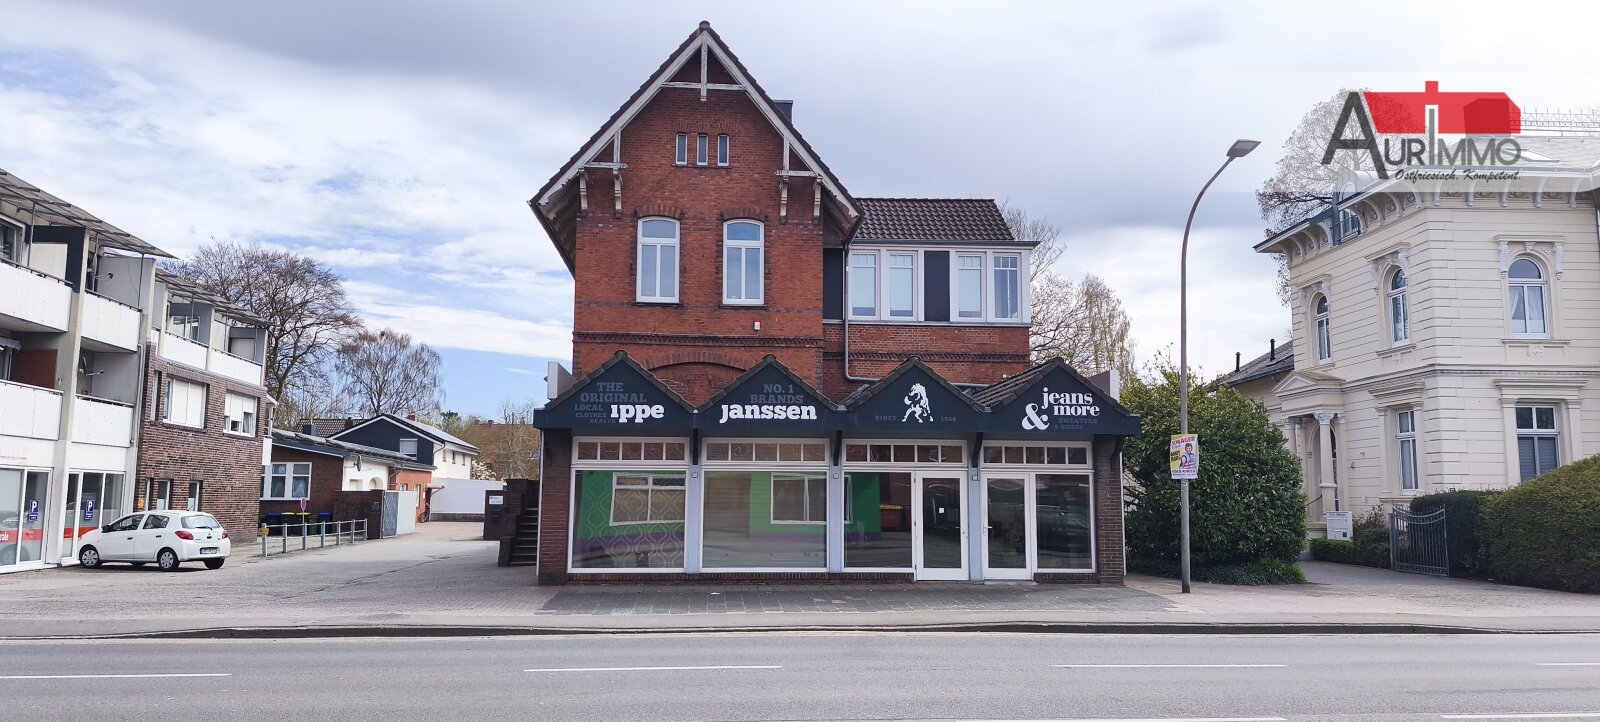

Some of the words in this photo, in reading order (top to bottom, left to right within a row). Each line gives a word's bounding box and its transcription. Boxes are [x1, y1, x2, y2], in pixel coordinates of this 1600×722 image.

[596, 382, 624, 392] THE
[763, 384, 785, 393] NO.
[788, 384, 794, 393] 1
[580, 392, 647, 402] ORIGINAL
[750, 394, 804, 404] BRANDS
[1041, 387, 1093, 409] jeans
[719, 404, 817, 424] janssen
[1021, 403, 1050, 430] &
[1053, 405, 1100, 416] more
[32, 501, 37, 512] P
[88, 501, 92, 512] P
